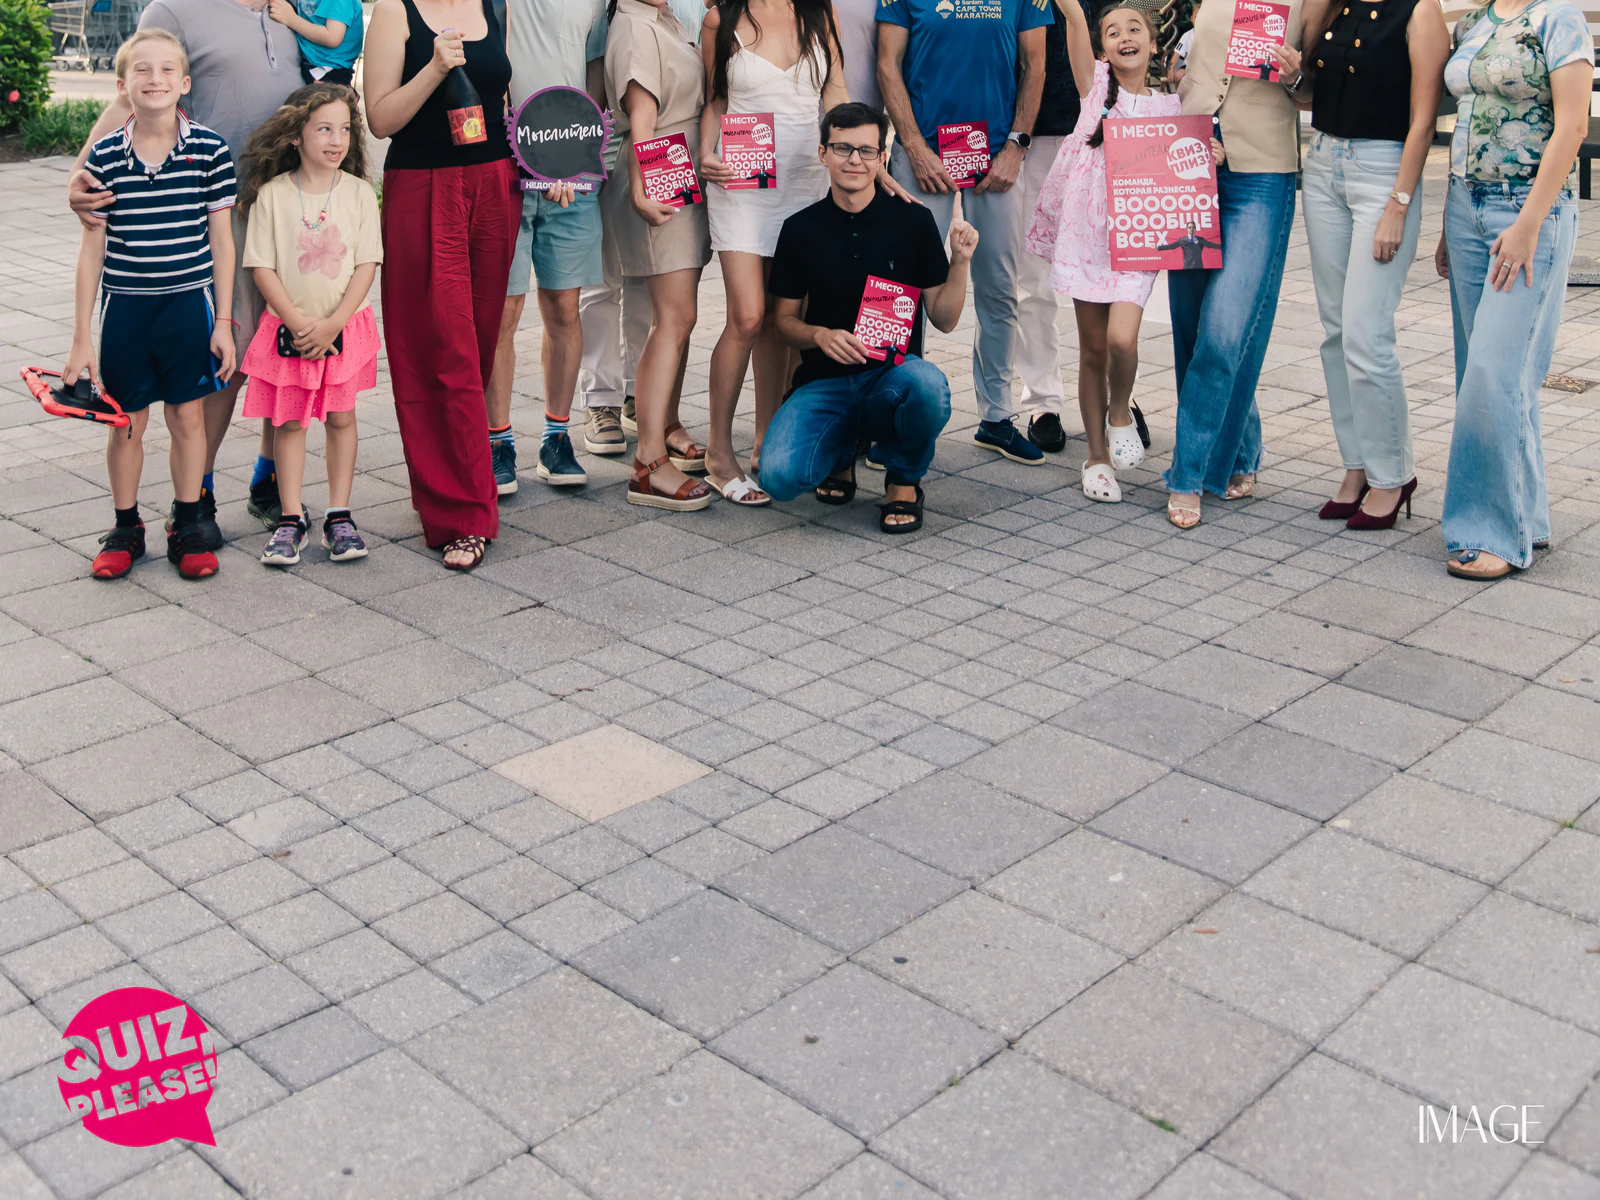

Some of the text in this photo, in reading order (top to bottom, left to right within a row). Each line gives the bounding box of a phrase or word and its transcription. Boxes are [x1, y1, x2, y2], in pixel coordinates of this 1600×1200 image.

[1243, 2, 1273, 13] МЕСТО
[1228, 54, 1256, 67] ВСЕХ
[724, 116, 758, 125] 1 МЕСТО
[946, 125, 972, 134] МЕСТО
[1111, 123, 1178, 139] 1 МЕСТО
[637, 139, 671, 153] 1 МЕСТО
[948, 171, 969, 180] СЕХ
[1112, 177, 1157, 186] КОМАНДЕ,
[645, 176, 695, 196] ОООБЩЕ
[1113, 185, 1197, 196] КОТОРАЯ РАЗНЕСЛА
[1116, 230, 1169, 249] ВСЕХ
[870, 279, 904, 294] 1 МЕСТО
